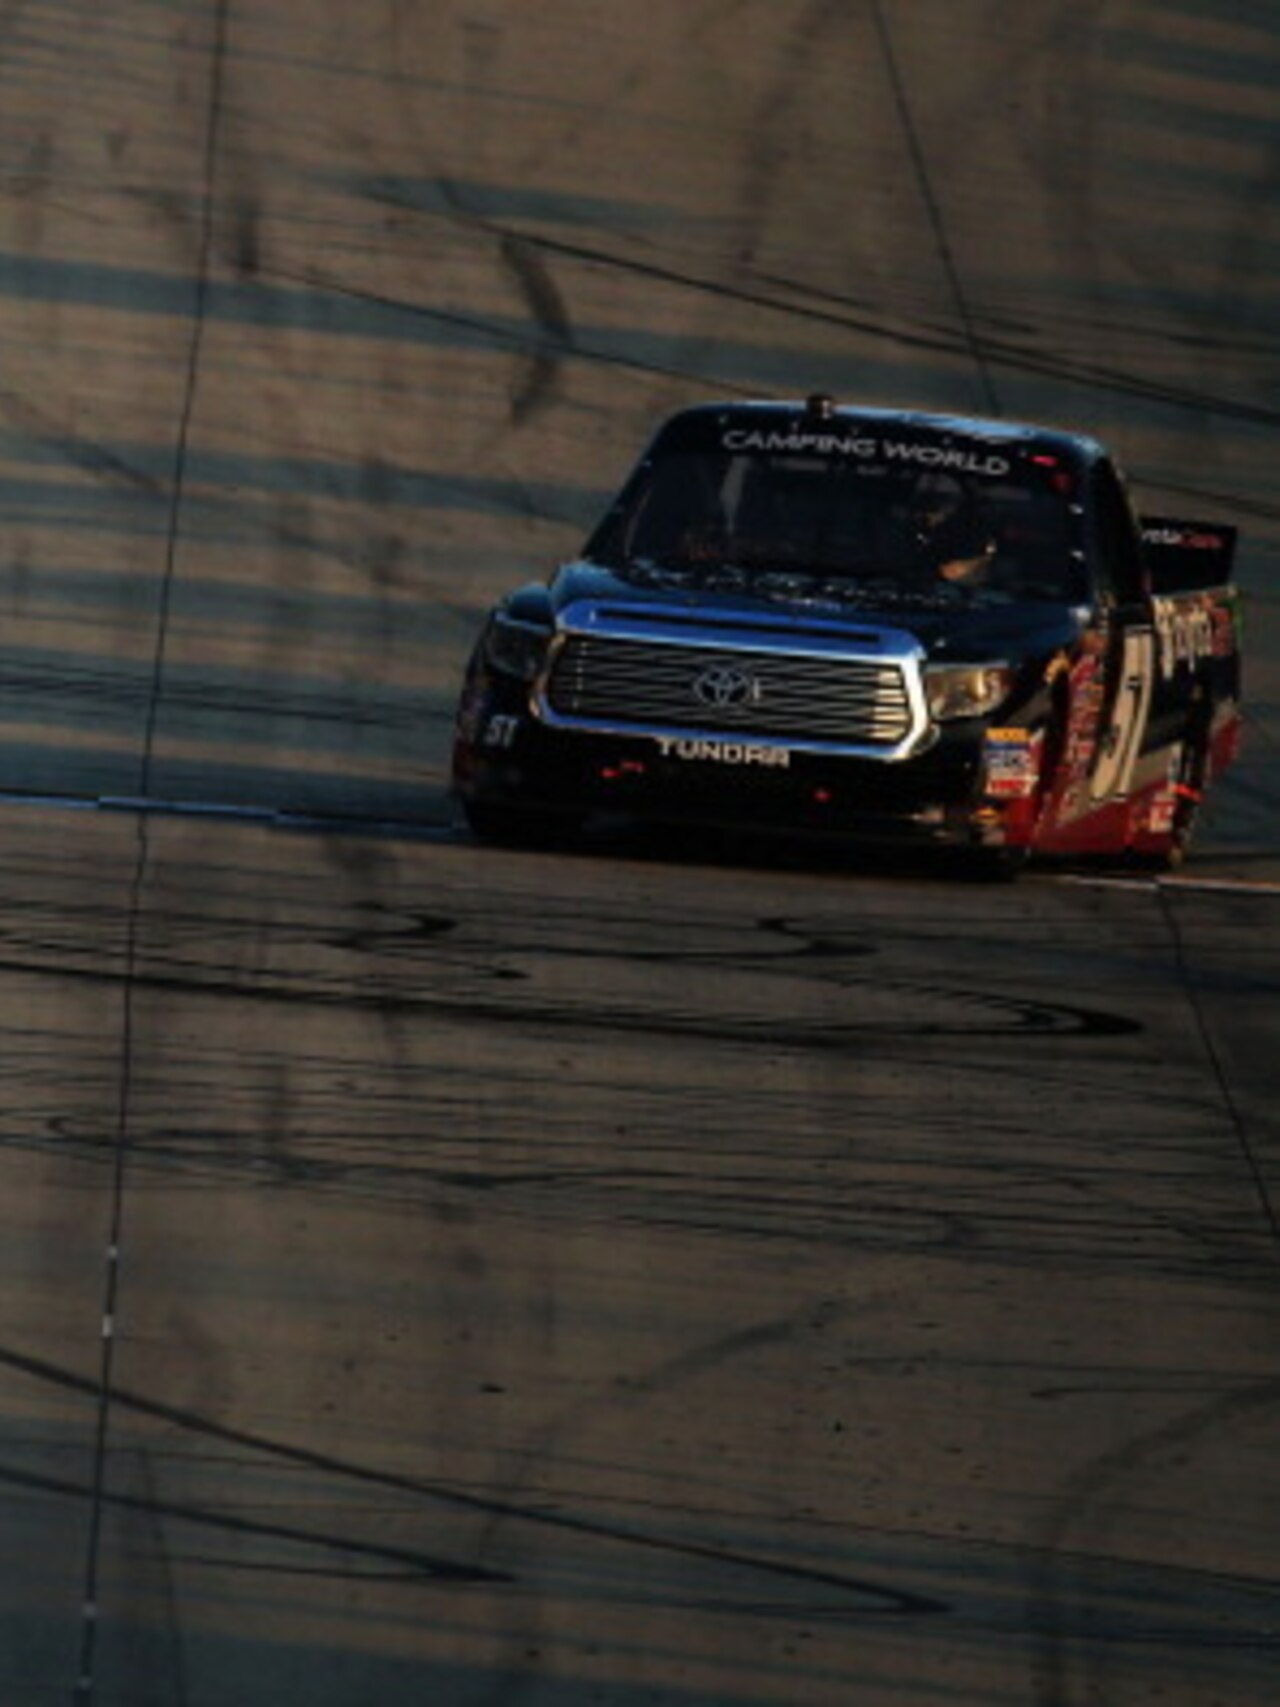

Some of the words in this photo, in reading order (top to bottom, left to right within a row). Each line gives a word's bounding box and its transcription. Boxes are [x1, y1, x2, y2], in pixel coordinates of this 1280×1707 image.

[722, 429, 877, 459] CAMPING
[882, 438, 1010, 476] WORLD
[655, 737, 790, 768] TUNDRA
